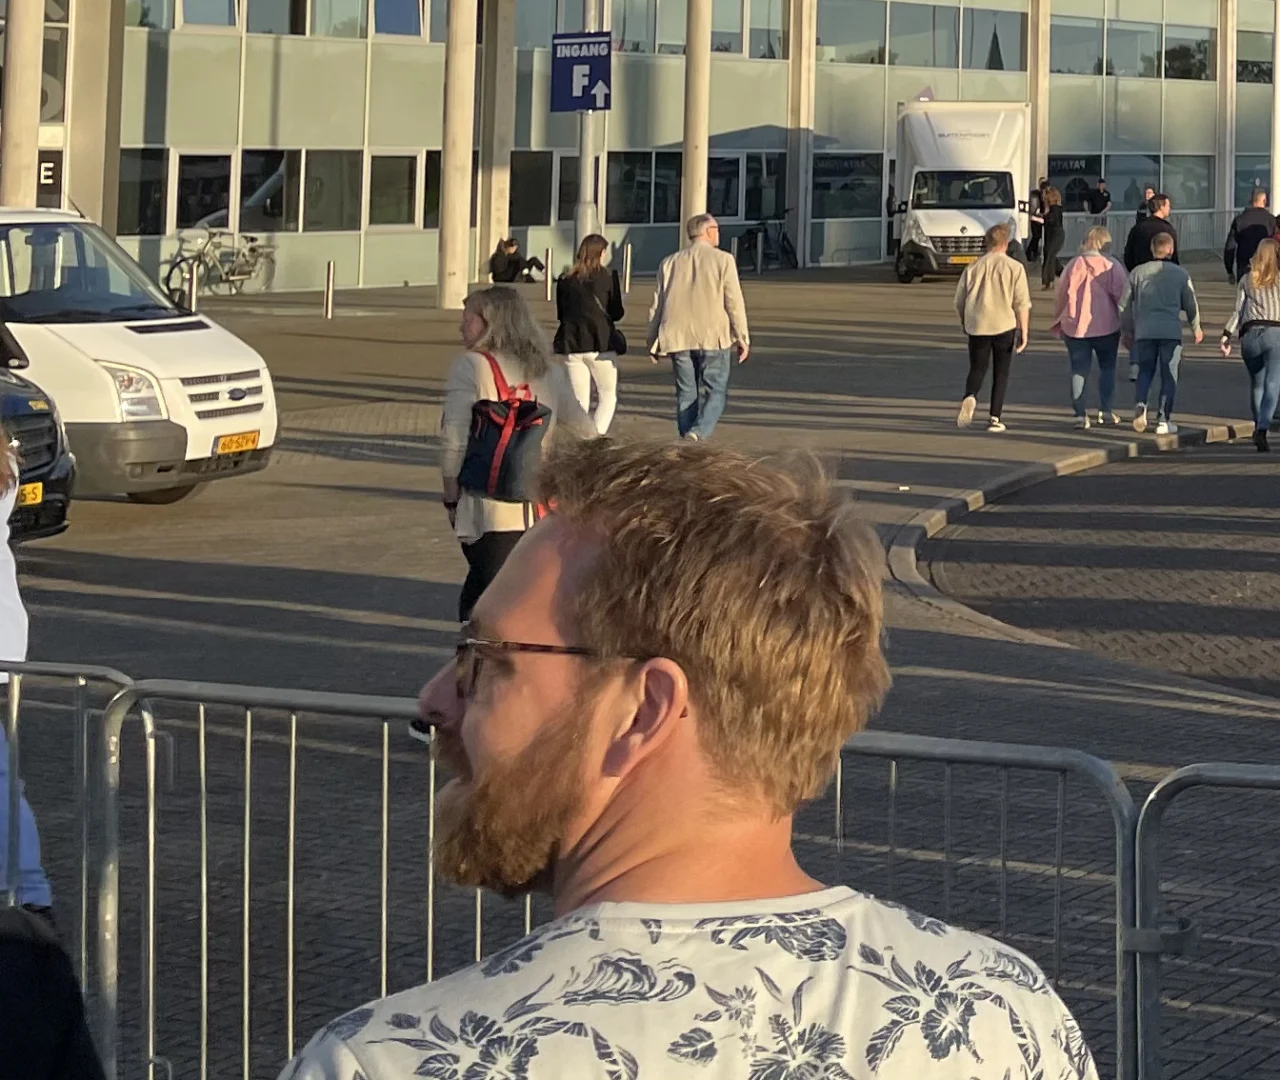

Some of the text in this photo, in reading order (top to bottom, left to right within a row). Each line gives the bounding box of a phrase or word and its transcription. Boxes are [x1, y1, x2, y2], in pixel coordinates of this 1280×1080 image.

[556, 43, 609, 58] INGANG
[572, 64, 590, 97] F
[40, 162, 54, 184] E
